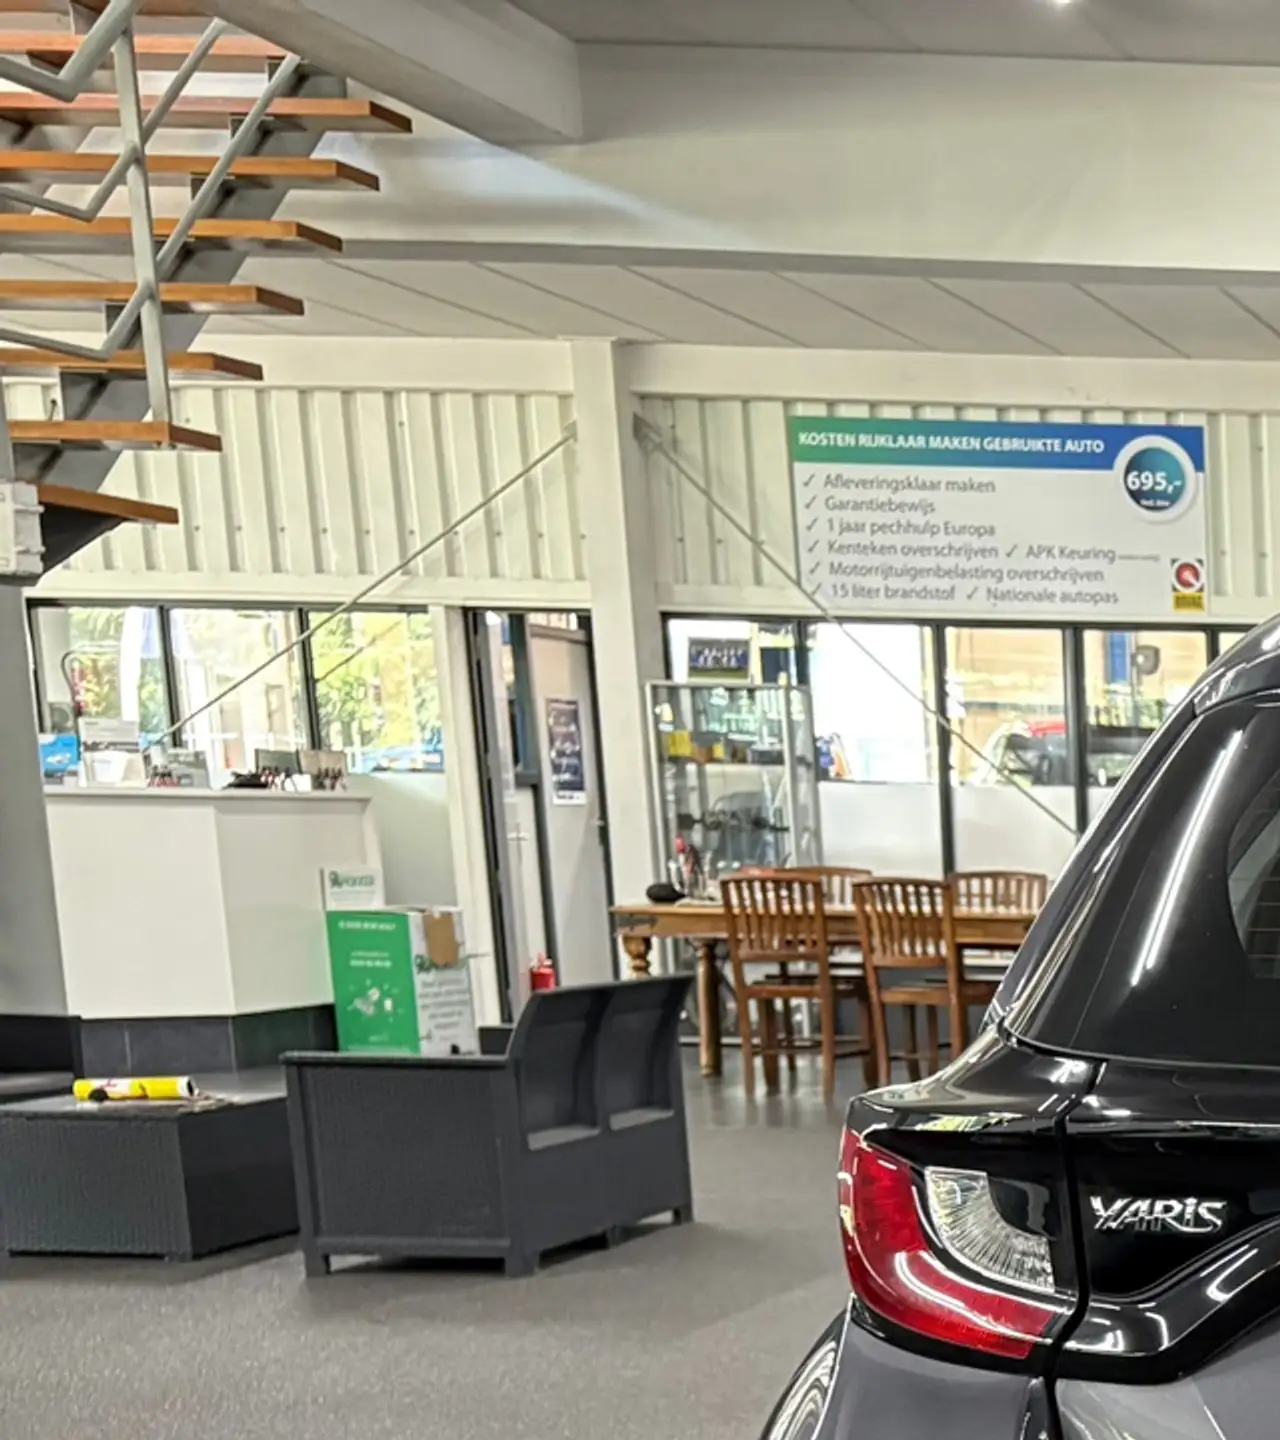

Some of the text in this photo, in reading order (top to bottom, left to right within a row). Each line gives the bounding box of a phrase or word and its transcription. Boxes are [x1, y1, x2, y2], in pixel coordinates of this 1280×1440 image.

[798, 431, 1105, 453] KOSTEN RIJKLAAR MAKEN GEBRUIKTE AUTO
[823, 473, 996, 494] Afleveringsklaar maken
[1126, 469, 1183, 494] 695,-
[823, 495, 937, 515] Garantiebewijs
[828, 518, 996, 538] 1 jaar pechhulp Europa
[827, 539, 999, 561] Kenteken overschrijven
[1025, 544, 1056, 560] APK
[1058, 545, 1116, 565] Keuring
[829, 561, 1105, 584] Motorrijtuigenbelasting overschrijven
[832, 583, 956, 600] 15 liter brandstof
[986, 586, 1119, 606] Nationale autopas
[1089, 1195, 1227, 1233] YARIS
